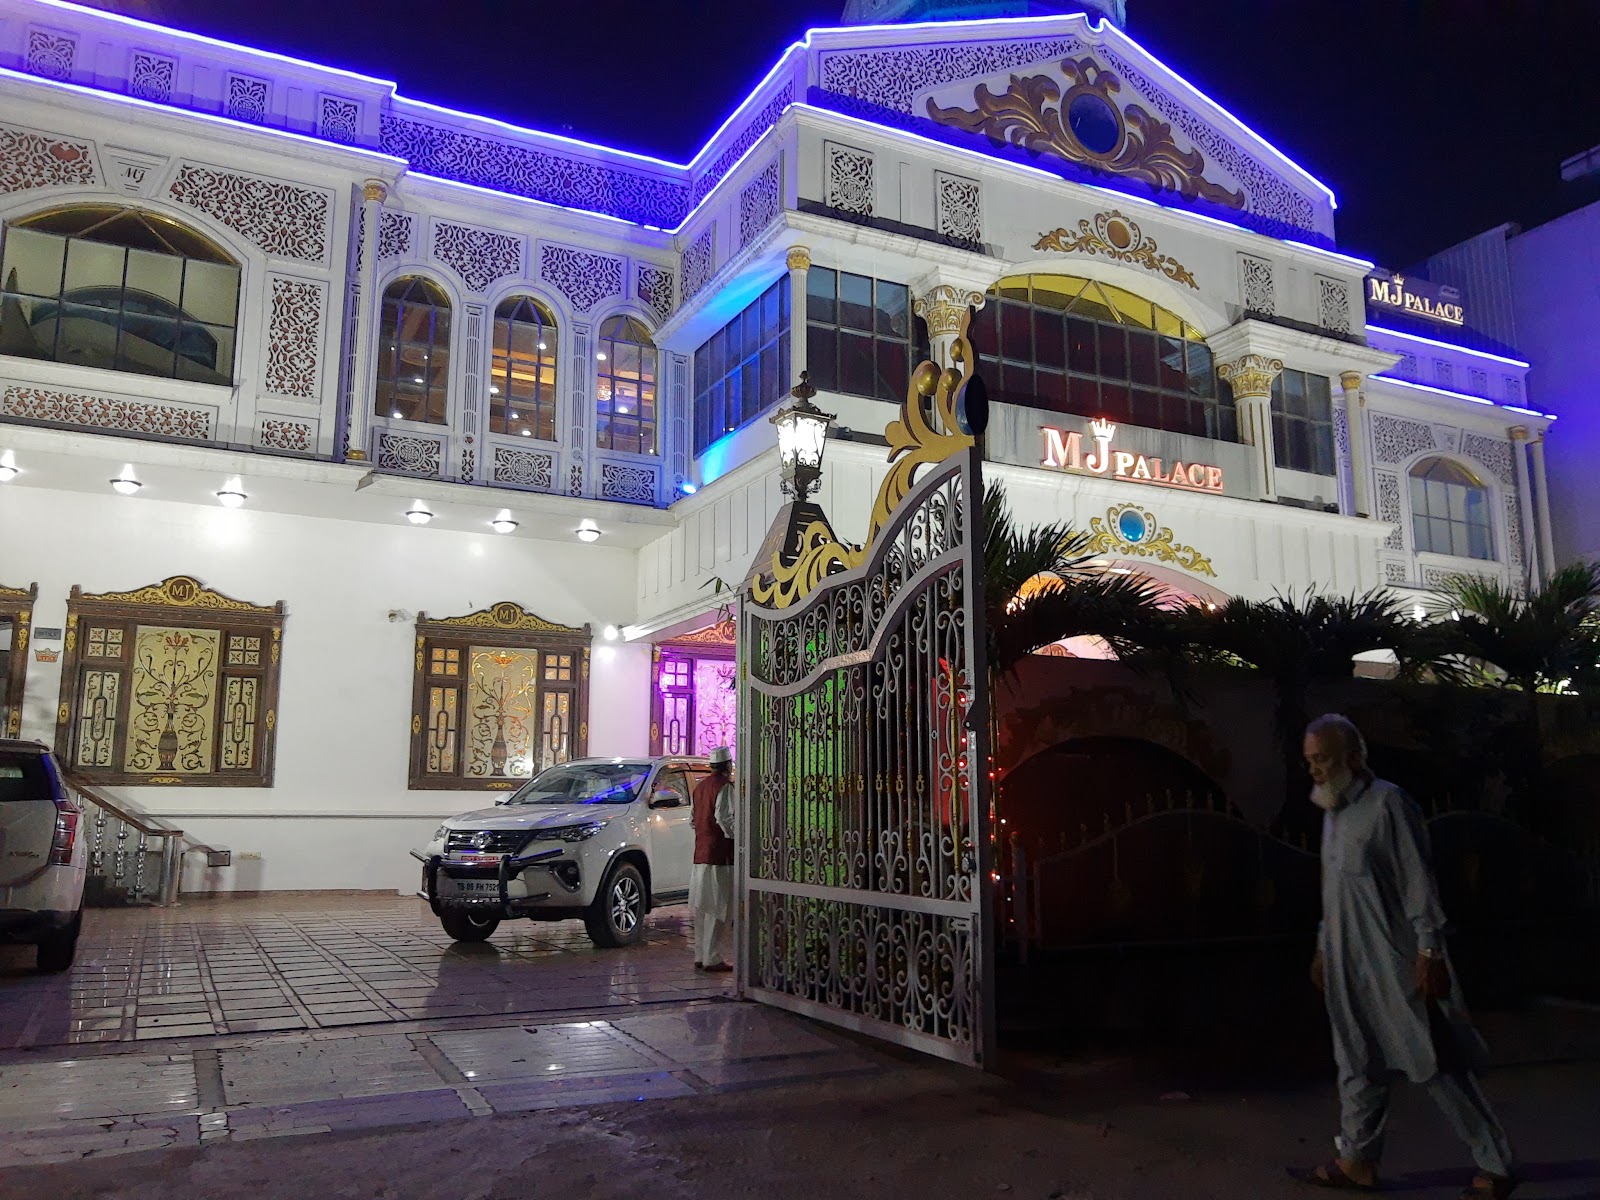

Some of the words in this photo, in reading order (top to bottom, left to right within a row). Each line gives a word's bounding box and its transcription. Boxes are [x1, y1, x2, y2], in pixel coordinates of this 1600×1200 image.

[1370, 278, 1403, 306] MJ
[1404, 292, 1463, 321] PALACE
[1039, 426, 1112, 473] MJ
[1113, 451, 1223, 490] PALACE
[171, 584, 191, 600] MJ
[499, 609, 515, 623] MJ
